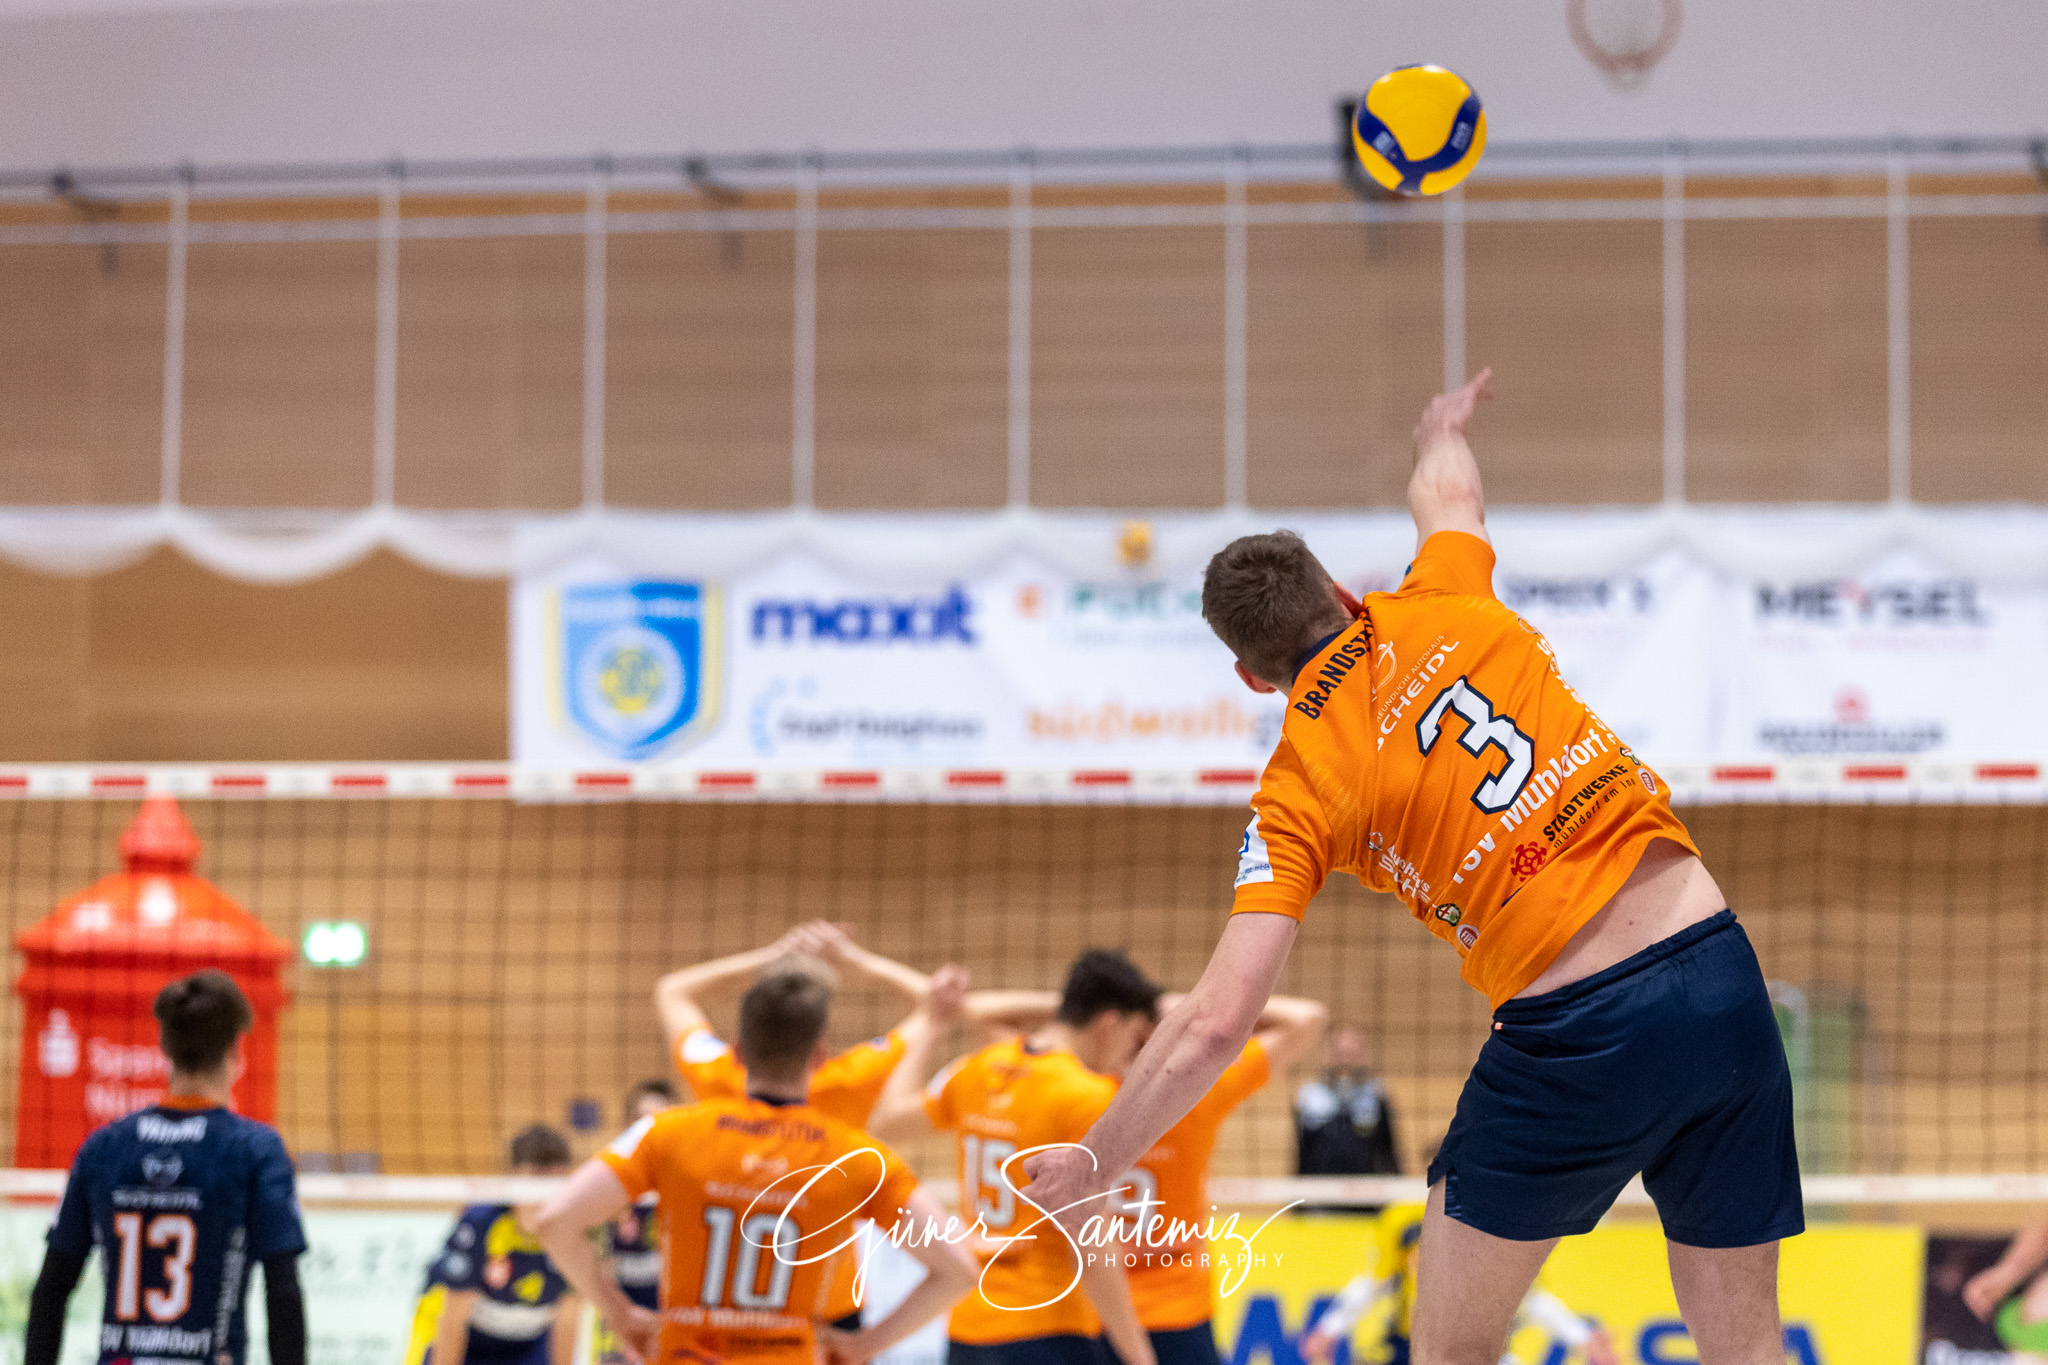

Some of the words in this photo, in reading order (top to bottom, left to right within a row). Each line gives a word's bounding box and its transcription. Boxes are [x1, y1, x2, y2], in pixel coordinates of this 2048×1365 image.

[751, 583, 978, 645] maxit
[1414, 673, 1536, 815] 3
[1543, 763, 1629, 842] STADTWERKE
[963, 1133, 1018, 1229] 15
[113, 1209, 198, 1323] 13
[700, 1206, 800, 1312] 10
